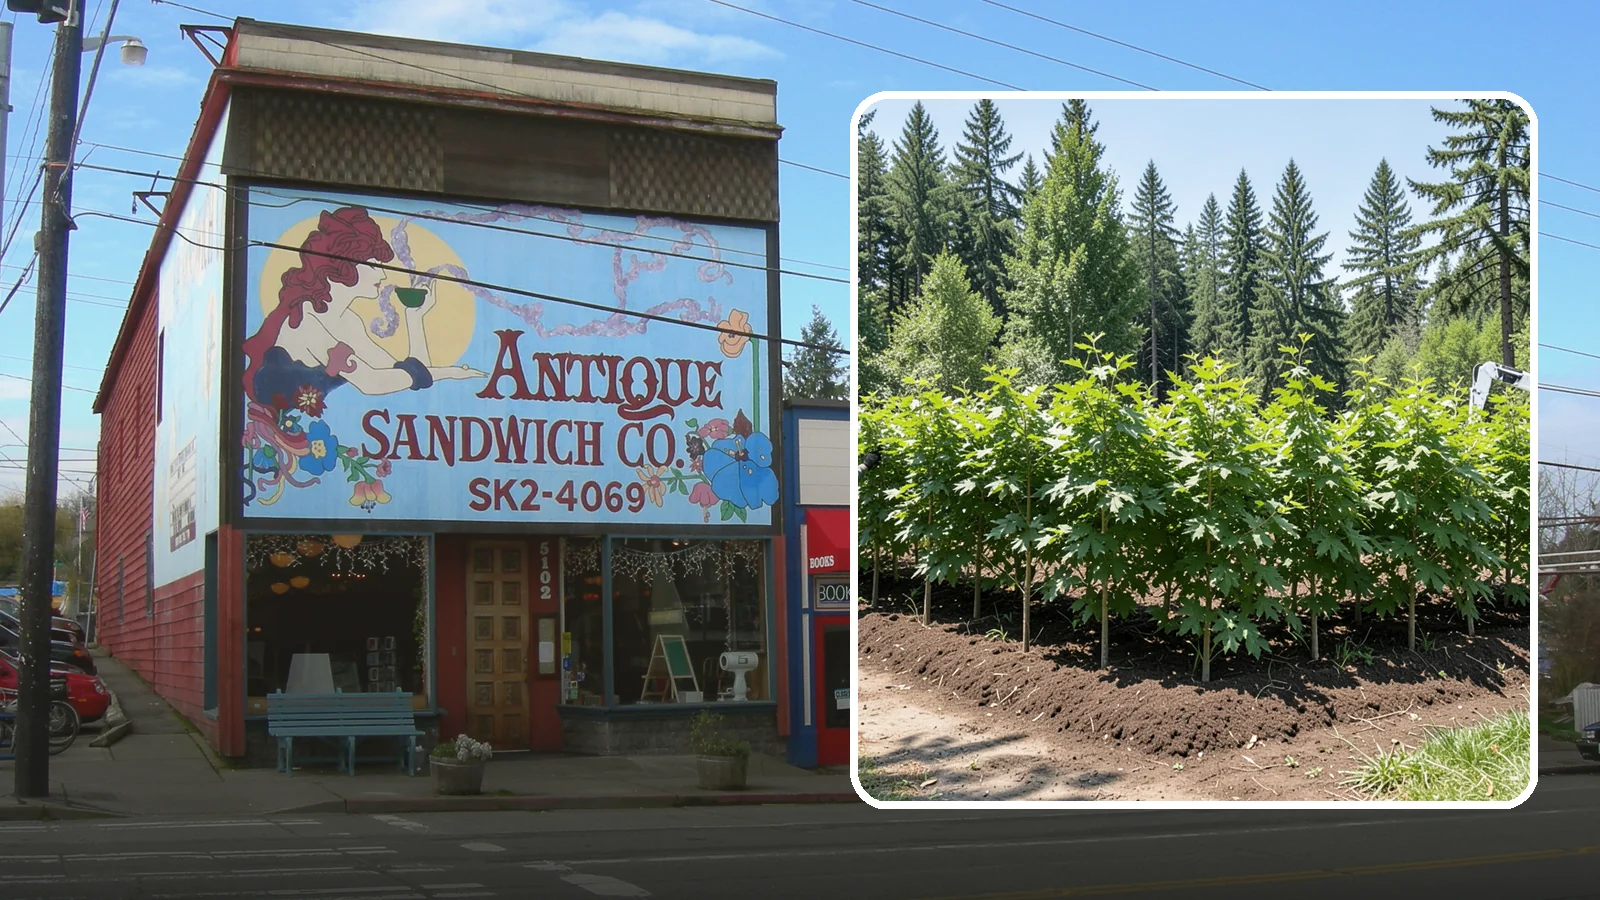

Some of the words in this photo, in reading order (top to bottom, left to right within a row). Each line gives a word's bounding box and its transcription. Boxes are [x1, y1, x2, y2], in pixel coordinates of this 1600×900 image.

[476, 329, 724, 420] ANTIQUE
[361, 409, 604, 467] SANDWICH
[616, 421, 685, 468] CO.
[468, 477, 645, 512] SK2-4069
[540, 542, 551, 599] 5102
[809, 555, 835, 569] BOOKS
